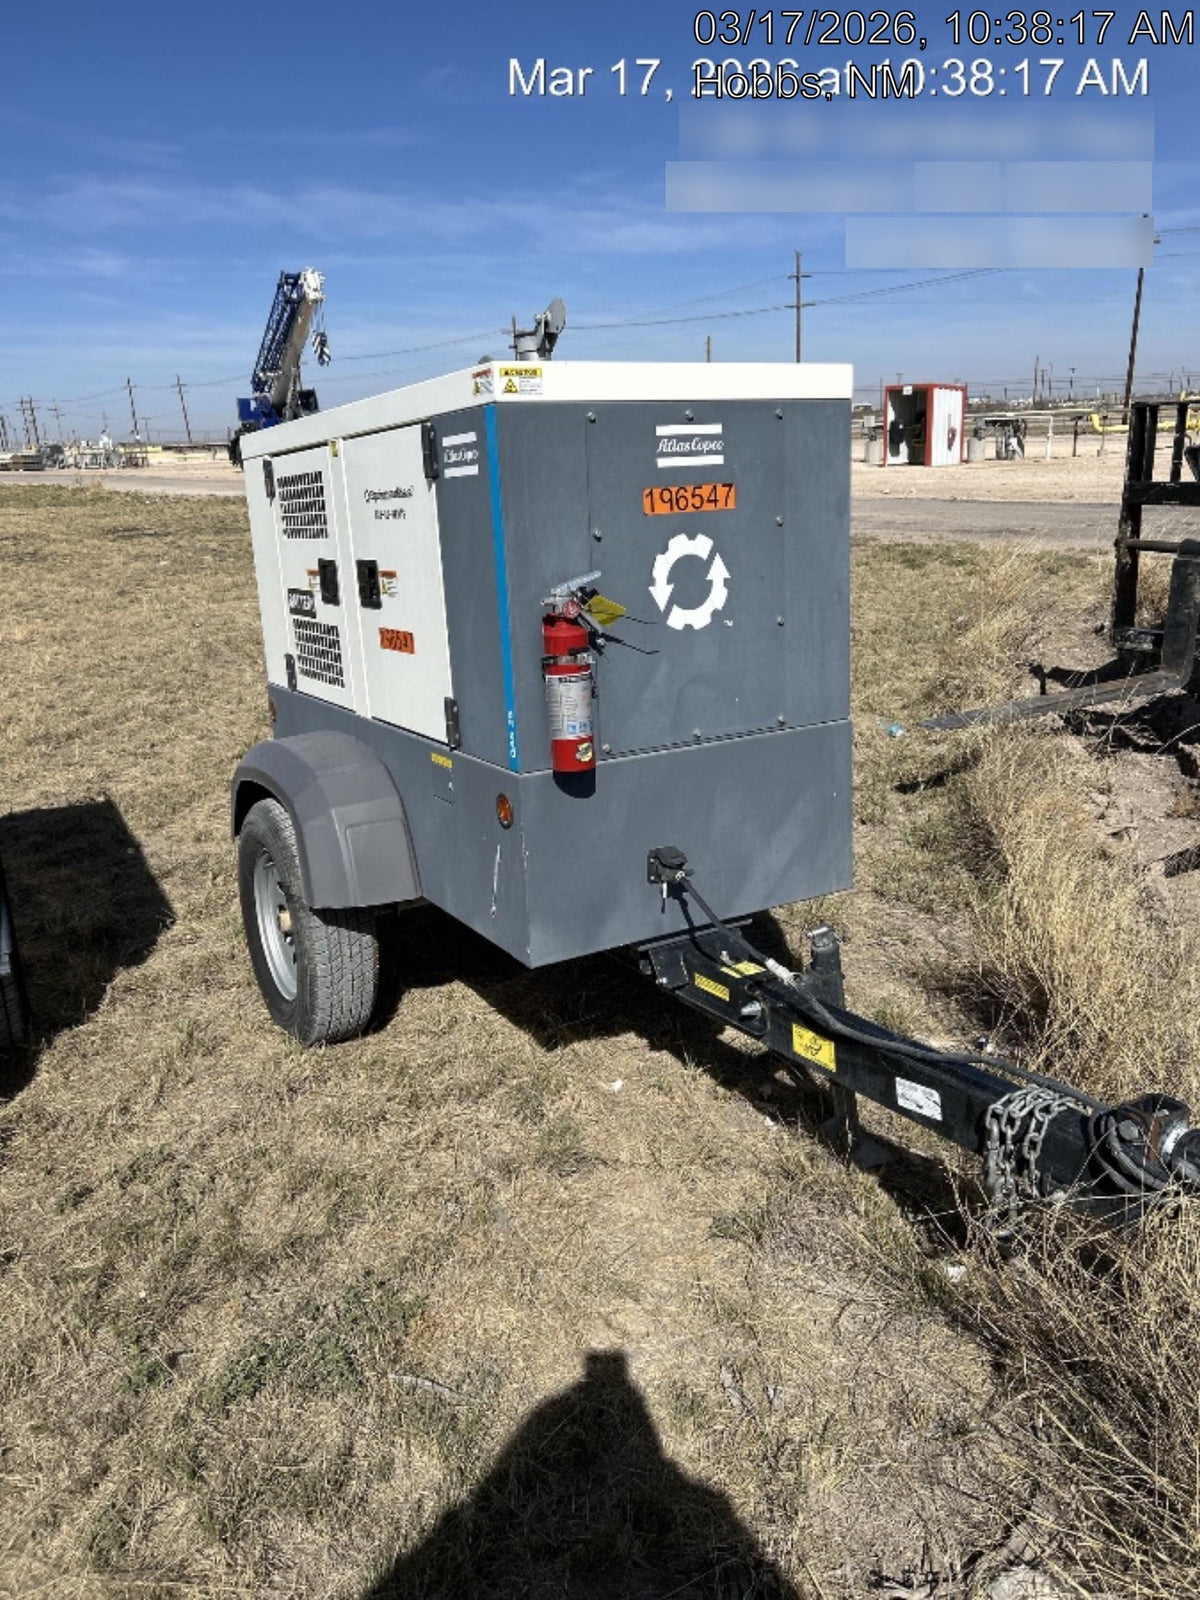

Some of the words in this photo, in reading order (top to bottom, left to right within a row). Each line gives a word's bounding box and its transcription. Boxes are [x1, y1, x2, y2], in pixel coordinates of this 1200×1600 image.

[656, 438, 690, 454] Atlas
[691, 436, 724, 453] Copco
[644, 483, 734, 513] 196547
